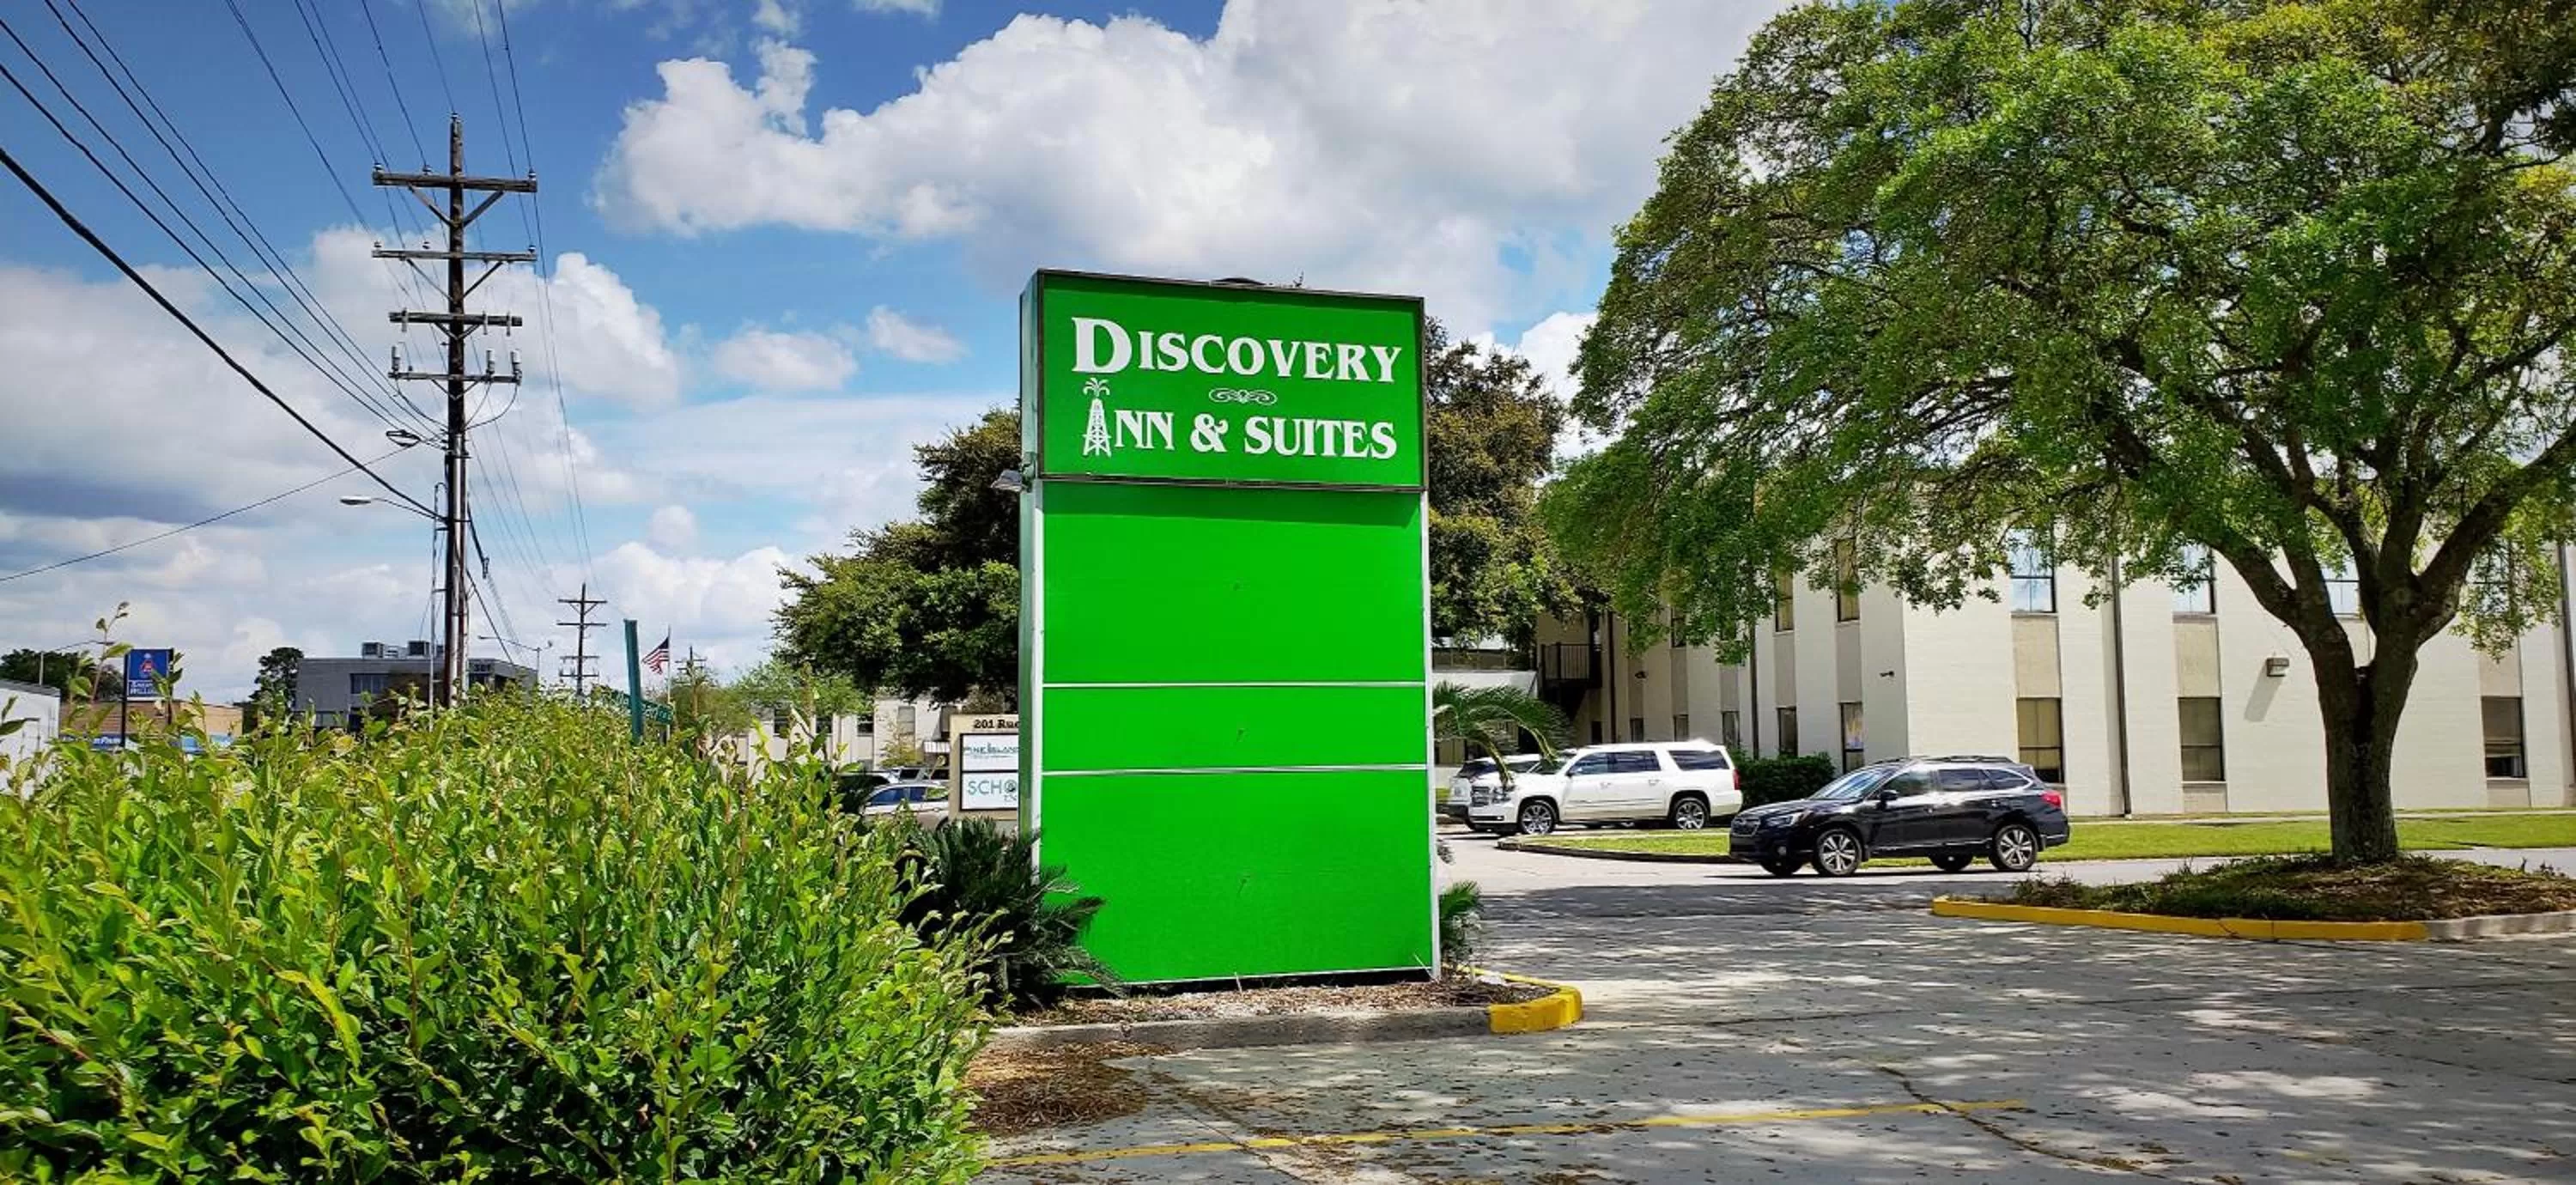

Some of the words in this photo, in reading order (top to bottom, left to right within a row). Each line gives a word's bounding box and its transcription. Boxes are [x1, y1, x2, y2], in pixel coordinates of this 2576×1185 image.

[1072, 317, 1402, 382] DISCOVERY
[1190, 413, 1229, 453] &
[1244, 416, 1398, 460] SUITES
[974, 719, 994, 729] 201
